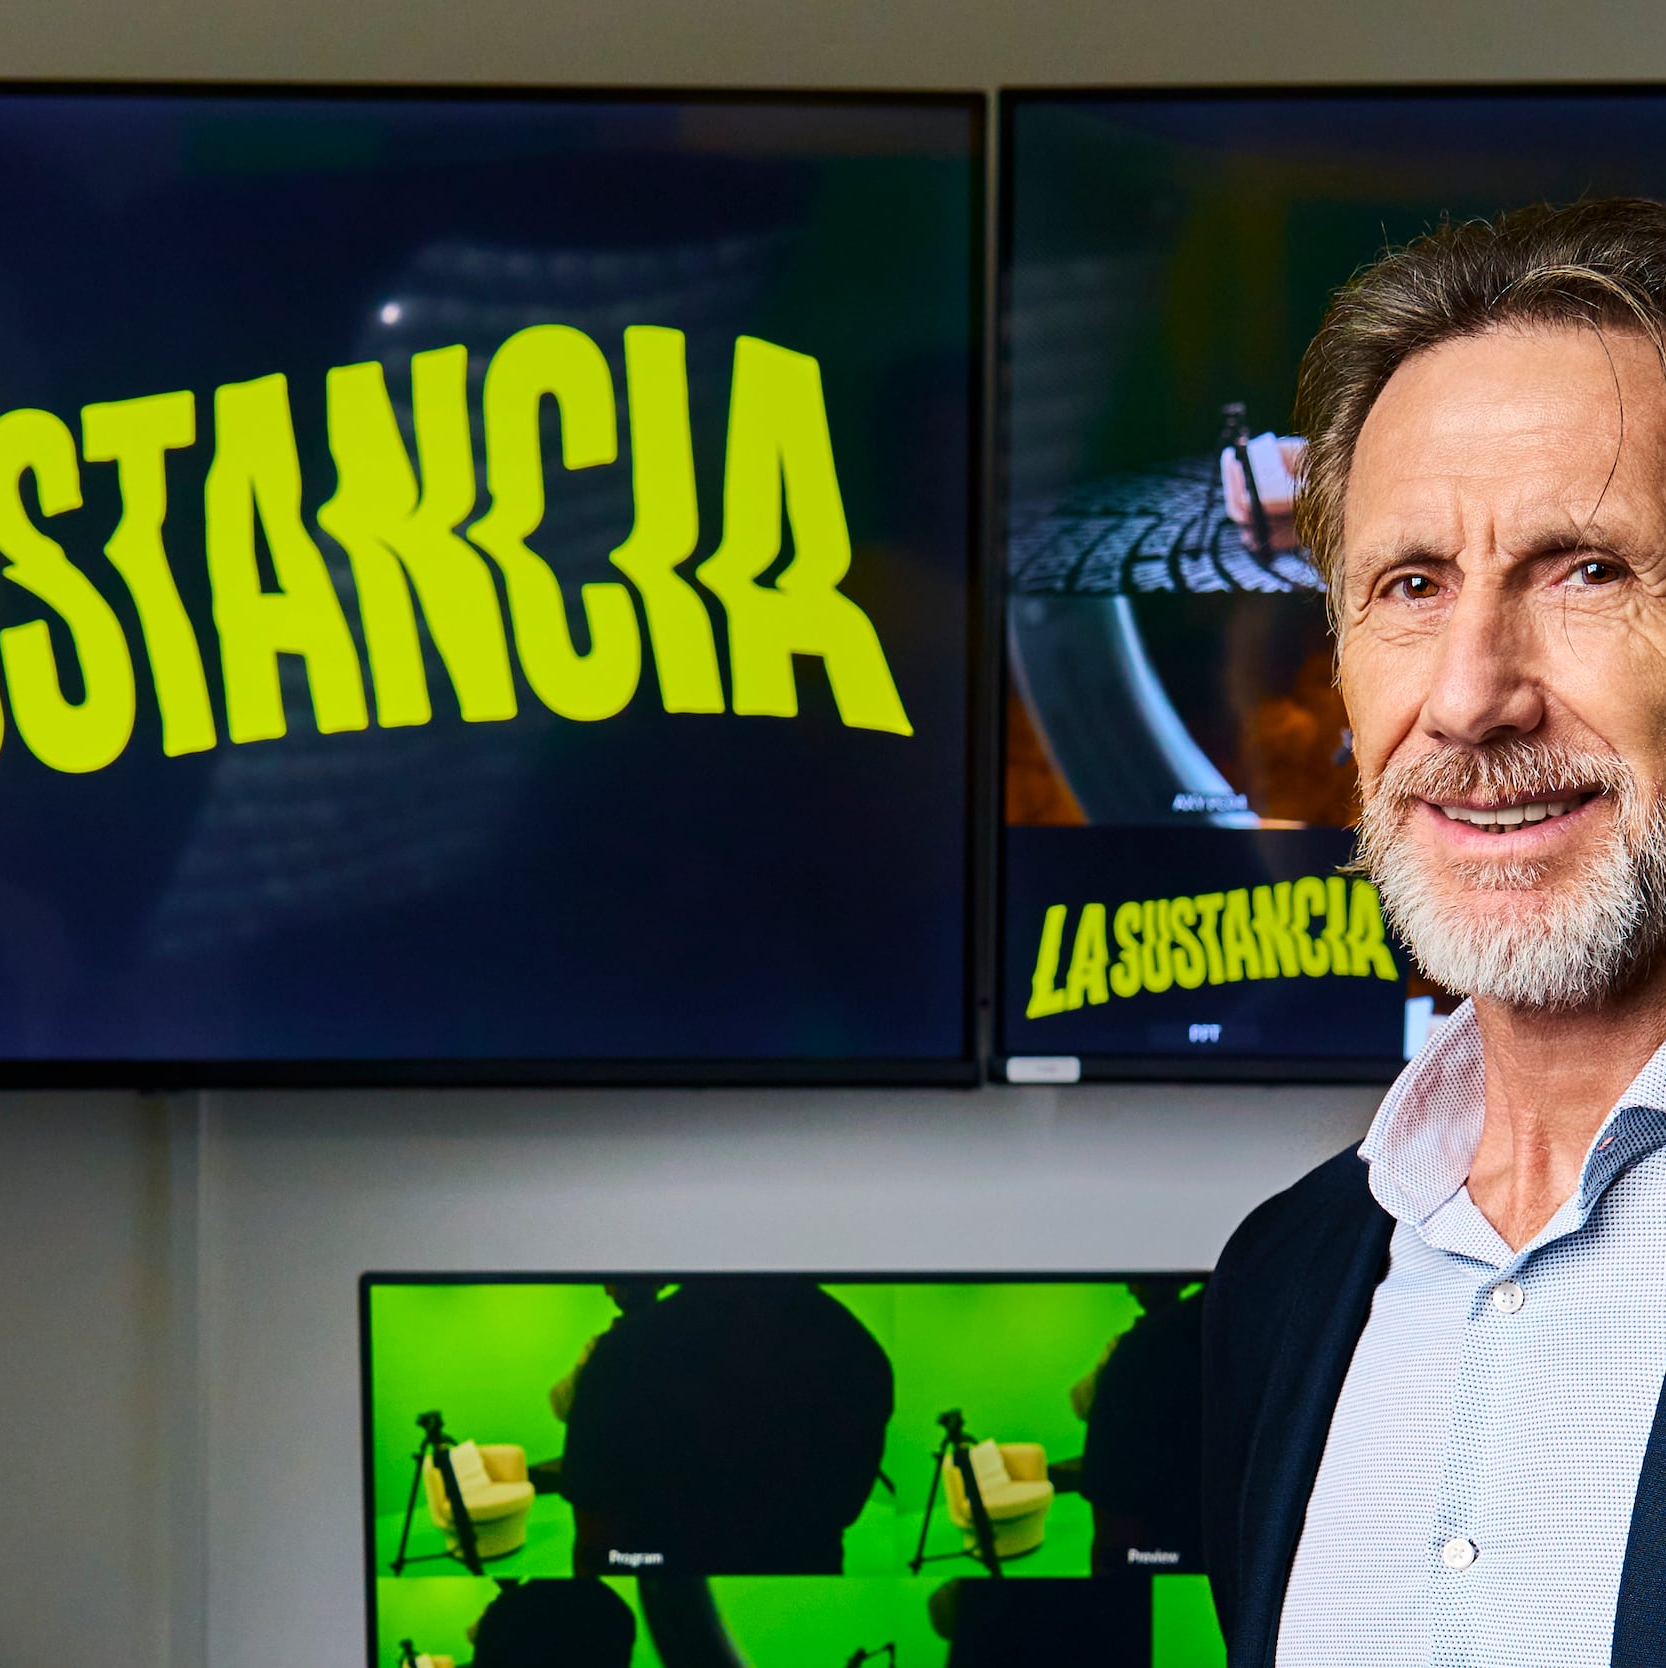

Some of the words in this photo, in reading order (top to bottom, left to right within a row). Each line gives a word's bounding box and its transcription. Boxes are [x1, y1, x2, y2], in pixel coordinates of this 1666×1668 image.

[1025, 903, 1110, 1020] LA
[1110, 876, 1400, 998] SUSTANCIA
[608, 1549, 665, 1568] Program
[1127, 1548, 1181, 1565] Preview
